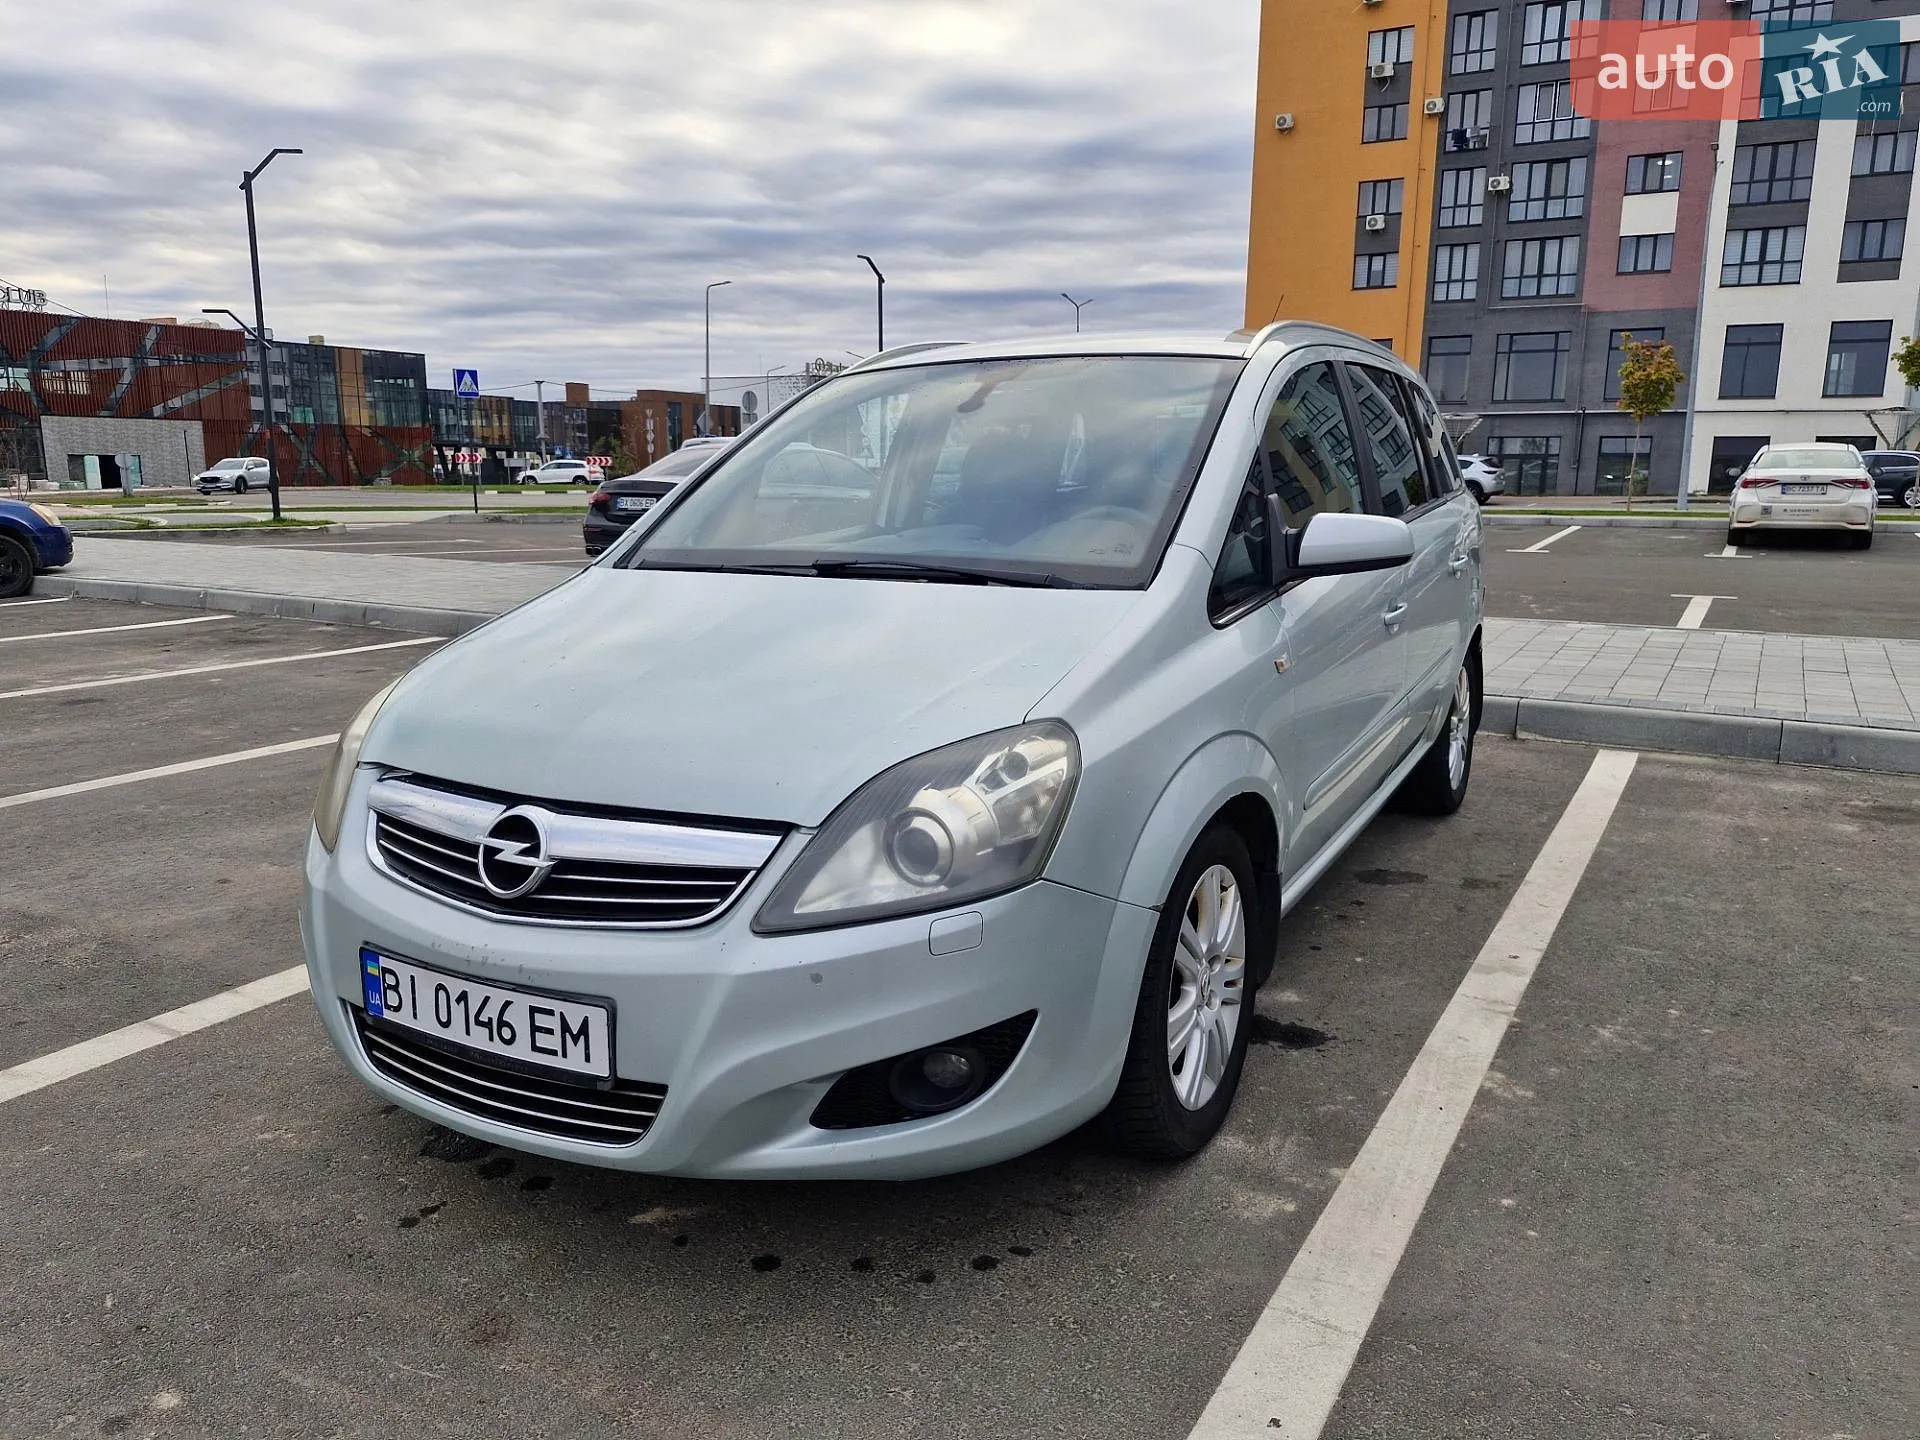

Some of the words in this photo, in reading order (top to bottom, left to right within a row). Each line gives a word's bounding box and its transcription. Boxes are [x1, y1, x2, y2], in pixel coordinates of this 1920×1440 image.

[368, 990, 382, 1006] UA
[381, 966, 418, 1021] BI
[434, 982, 517, 1046] 0146
[528, 1004, 591, 1063] EM
